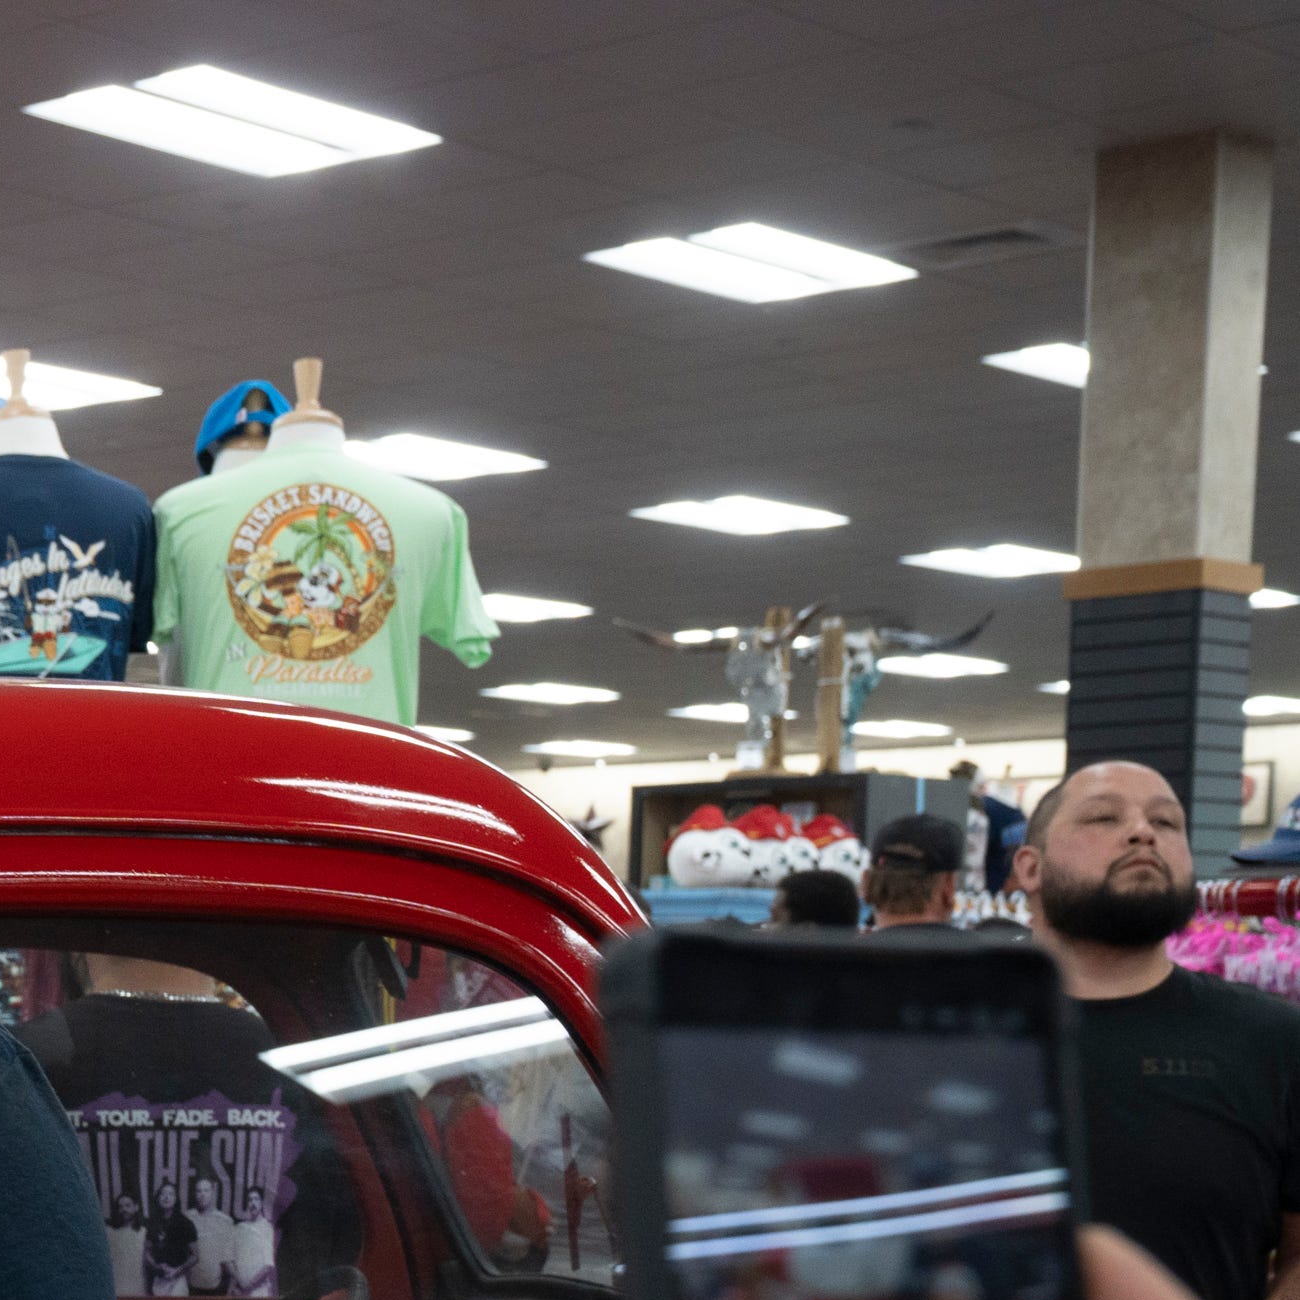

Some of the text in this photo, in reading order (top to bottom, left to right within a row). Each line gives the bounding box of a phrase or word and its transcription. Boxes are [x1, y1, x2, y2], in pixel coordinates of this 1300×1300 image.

[234, 484, 392, 551] BRISKET SANDWICH
[245, 655, 374, 684] Paradise
[95, 1109, 154, 1127] TOUR.
[162, 1109, 219, 1127] FADE.
[227, 1108, 286, 1128] BACK.
[135, 1130, 199, 1218] THE
[210, 1129, 284, 1222] SUN
